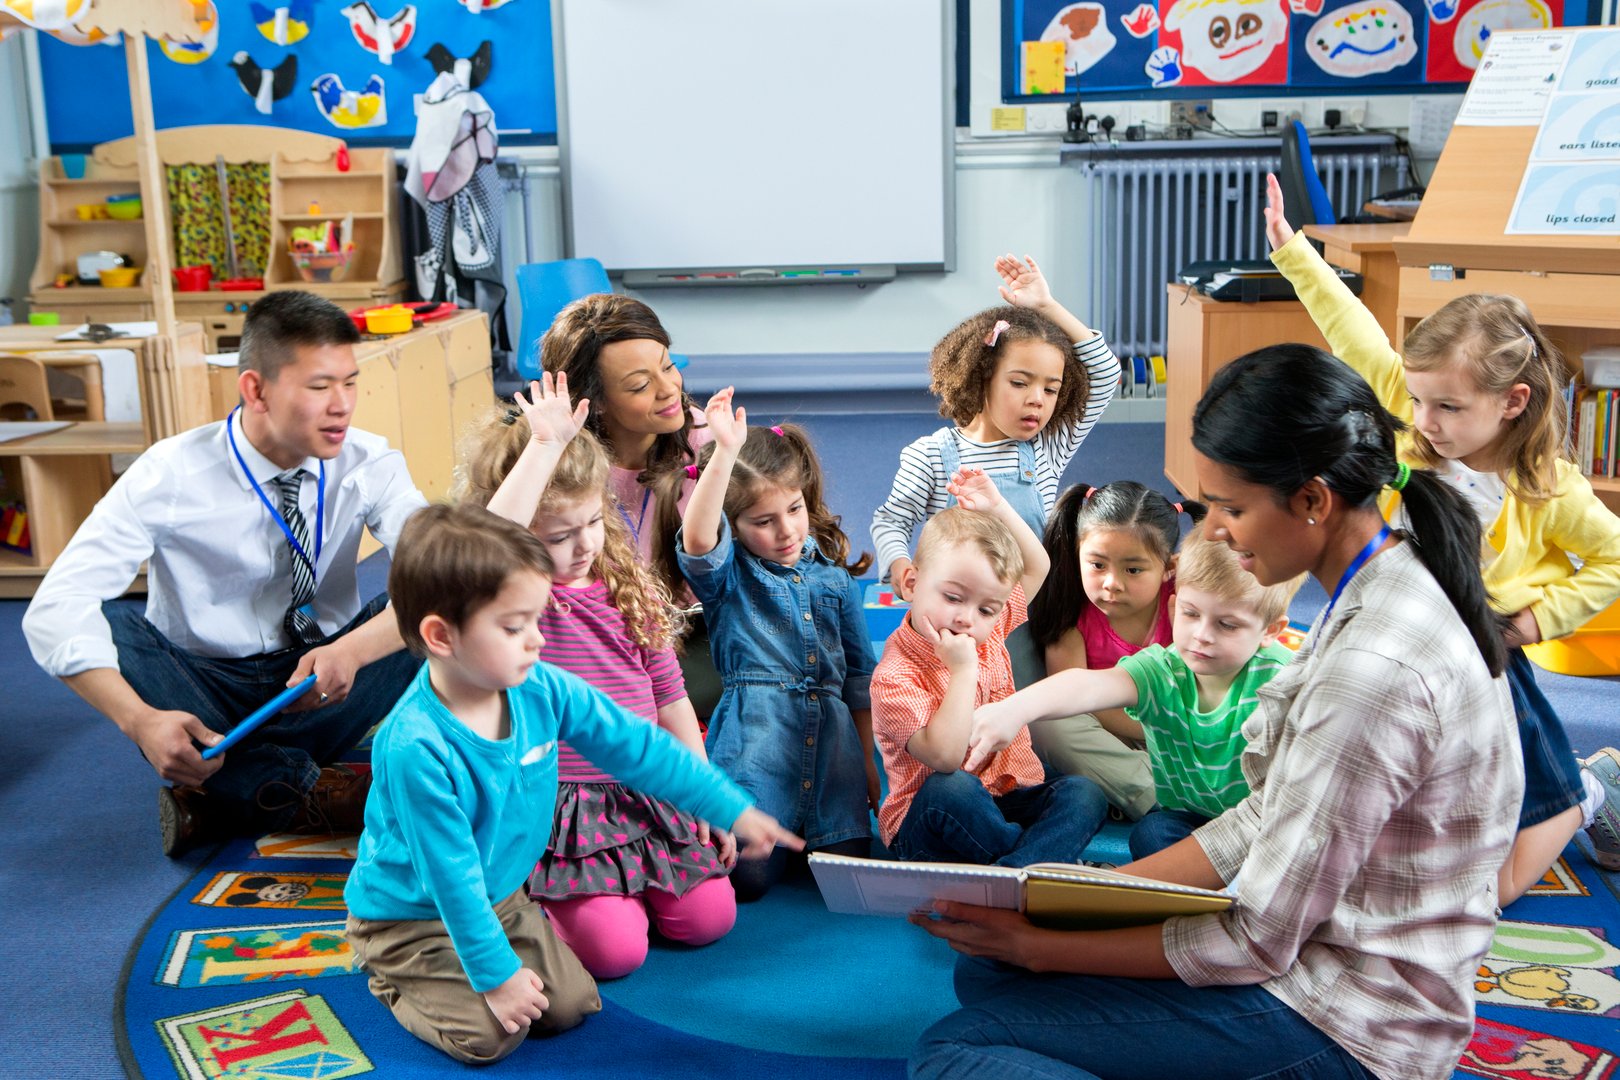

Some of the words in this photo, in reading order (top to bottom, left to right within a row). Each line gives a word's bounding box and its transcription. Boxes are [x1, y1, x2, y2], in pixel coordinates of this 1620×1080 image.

[1585, 77, 1618, 88] good
[1590, 140, 1620, 149] liste
[1545, 214, 1569, 226] lips
[1573, 214, 1616, 223] closed
[197, 1000, 329, 1071] K
